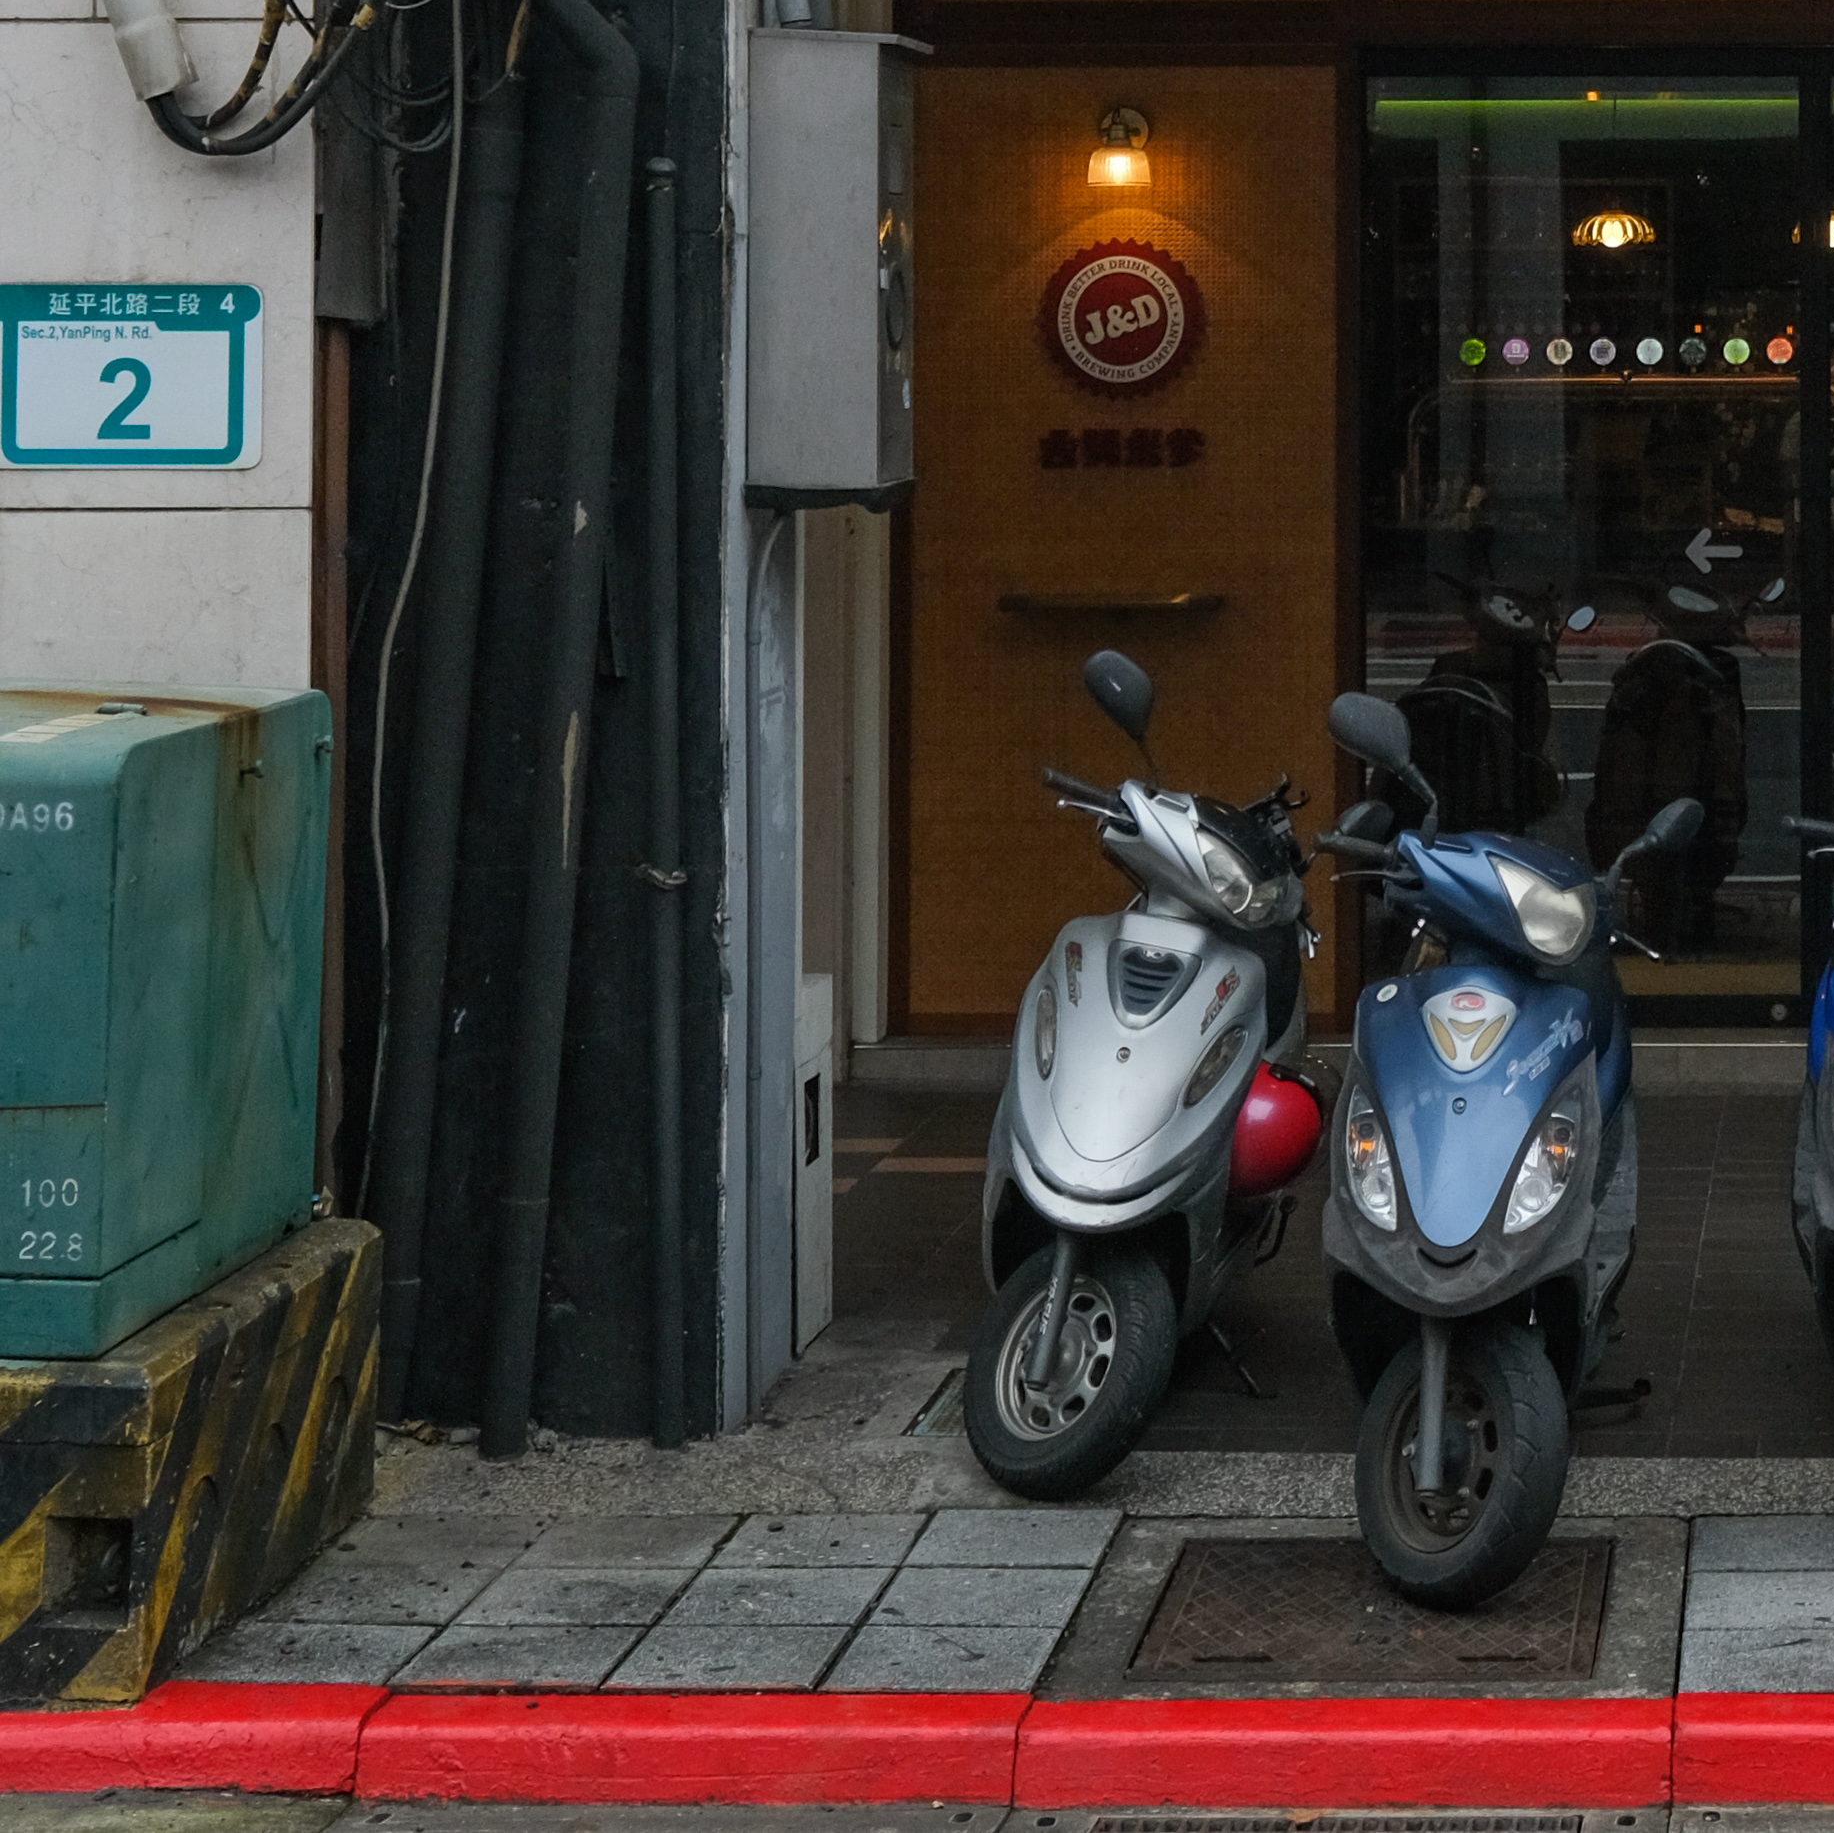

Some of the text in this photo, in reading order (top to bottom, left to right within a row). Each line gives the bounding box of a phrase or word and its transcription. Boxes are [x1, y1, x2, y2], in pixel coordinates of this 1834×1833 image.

[49, 292, 236, 316] 延平北路二段 4
[1066, 262, 1106, 299] BETTER
[1108, 259, 1151, 275] DRINK
[1150, 270, 1179, 310] LOCAL
[115, 326, 128, 339] N.
[131, 326, 153, 339] Rd.
[1084, 294, 1161, 345] J&D
[1074, 320, 1181, 380] BREWING COMPANY
[97, 357, 152, 440] 2
[21, 1178, 79, 1208] 100
